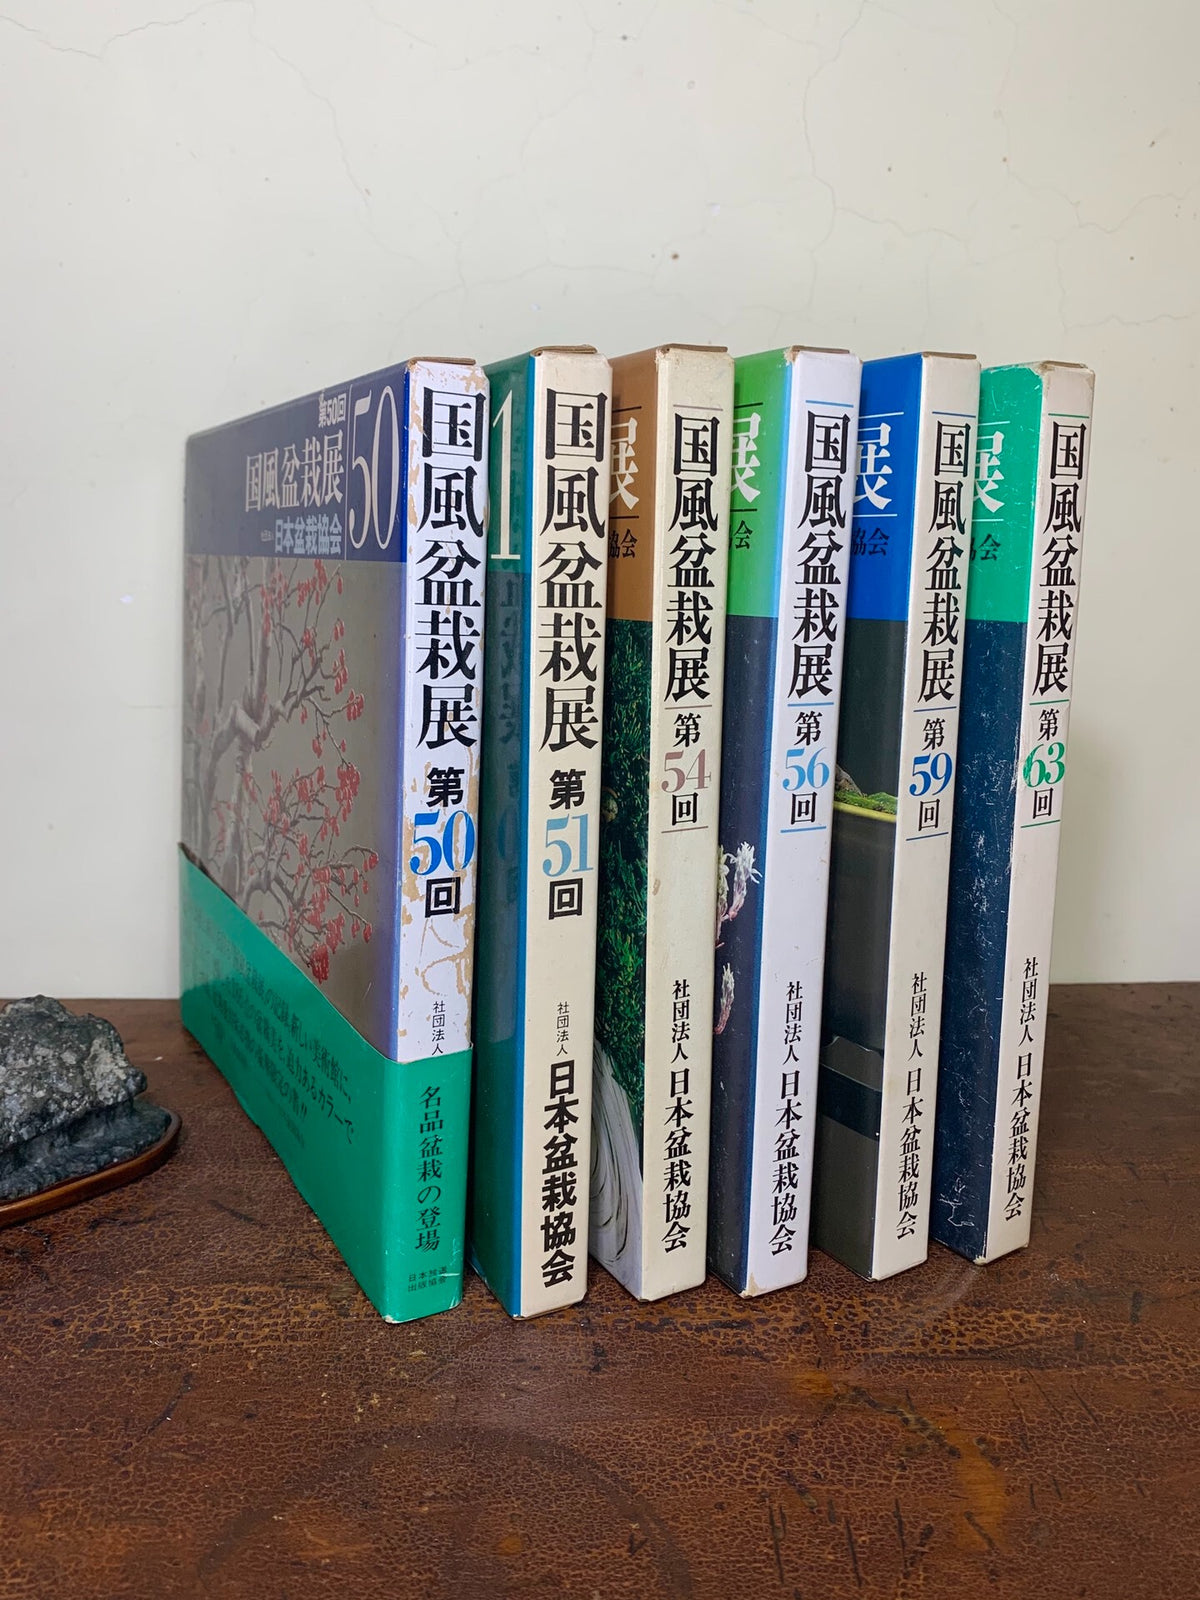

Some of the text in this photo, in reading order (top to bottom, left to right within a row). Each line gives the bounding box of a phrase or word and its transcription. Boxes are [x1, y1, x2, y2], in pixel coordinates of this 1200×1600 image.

[245, 430, 345, 513] 国風盆栽展
[274, 513, 343, 555] 日本盆栽協会
[317, 392, 347, 428] 第50回
[349, 385, 400, 550] 50
[729, 519, 753, 551] 会
[414, 386, 487, 750] 国風盆栽展
[537, 387, 608, 752] 国風盆栽展
[664, 412, 720, 702] 国風盆栽展
[787, 410, 851, 699] 国風盆栽展
[917, 420, 971, 703] 国風盆栽展
[1032, 421, 1088, 697] 国風盆栽展
[431, 1000, 446, 1056] 社団法人
[540, 1001, 580, 1288] 社団法人 日本盆栽協会
[661, 979, 694, 1254] 社団法人 日本盆栽協会
[768, 981, 803, 1256] 社団法人 日本盆栽協会
[896, 971, 928, 1240] 社団法人 日本盆栽協会
[1003, 956, 1039, 1221] 社団法人 日本盆栽協会
[415, 1085, 444, 1251] 名品盆栽の登場
